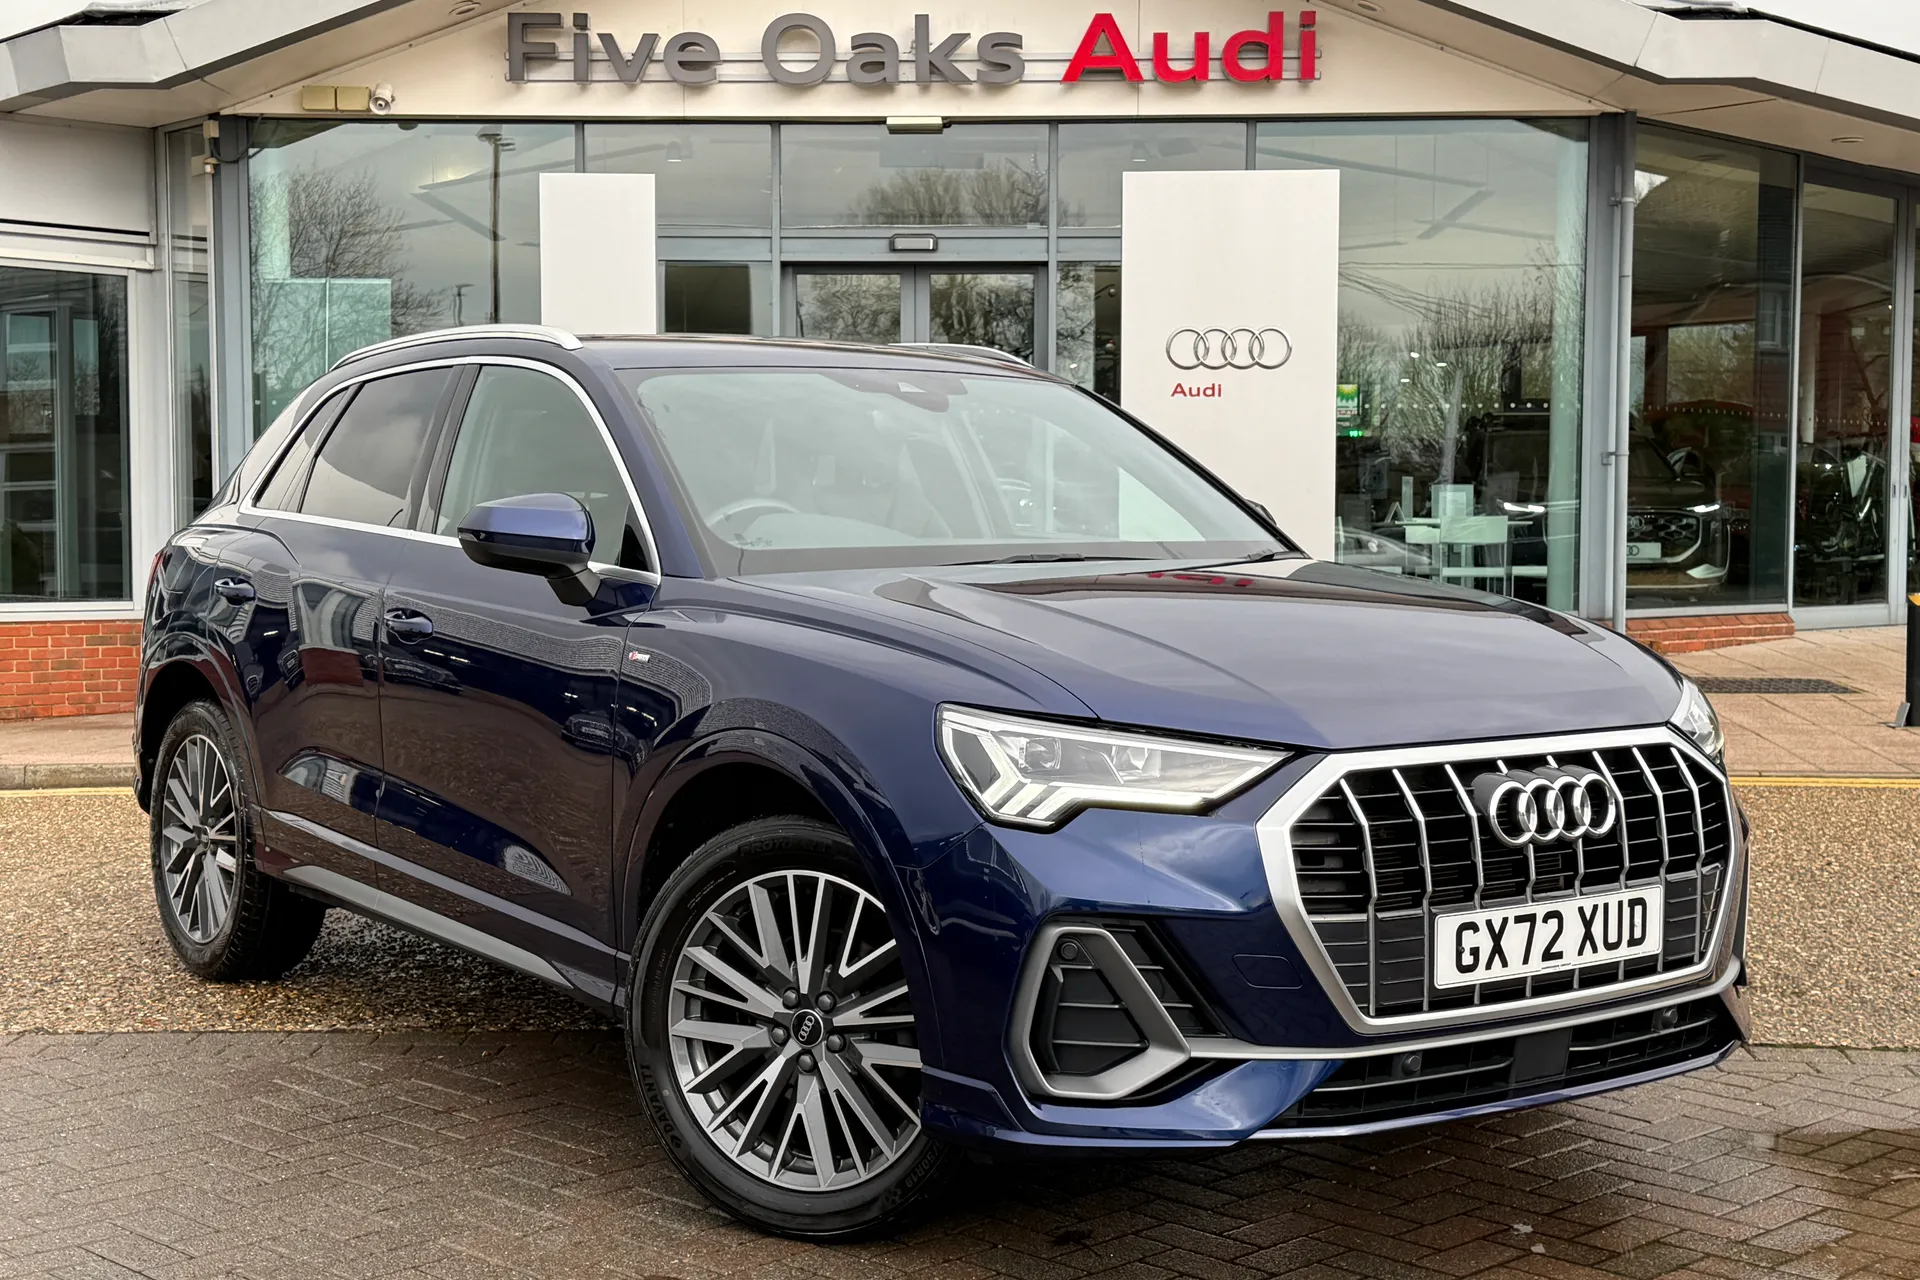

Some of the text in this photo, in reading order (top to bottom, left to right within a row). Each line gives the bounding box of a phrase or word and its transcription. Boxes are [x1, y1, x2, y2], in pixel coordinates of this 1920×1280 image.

[507, 10, 1317, 86] Five Oaks Audi
[1170, 382, 1222, 398] Audi
[1455, 896, 1648, 974] GX72 XUD
[639, 1064, 675, 1133] DAVANTI
